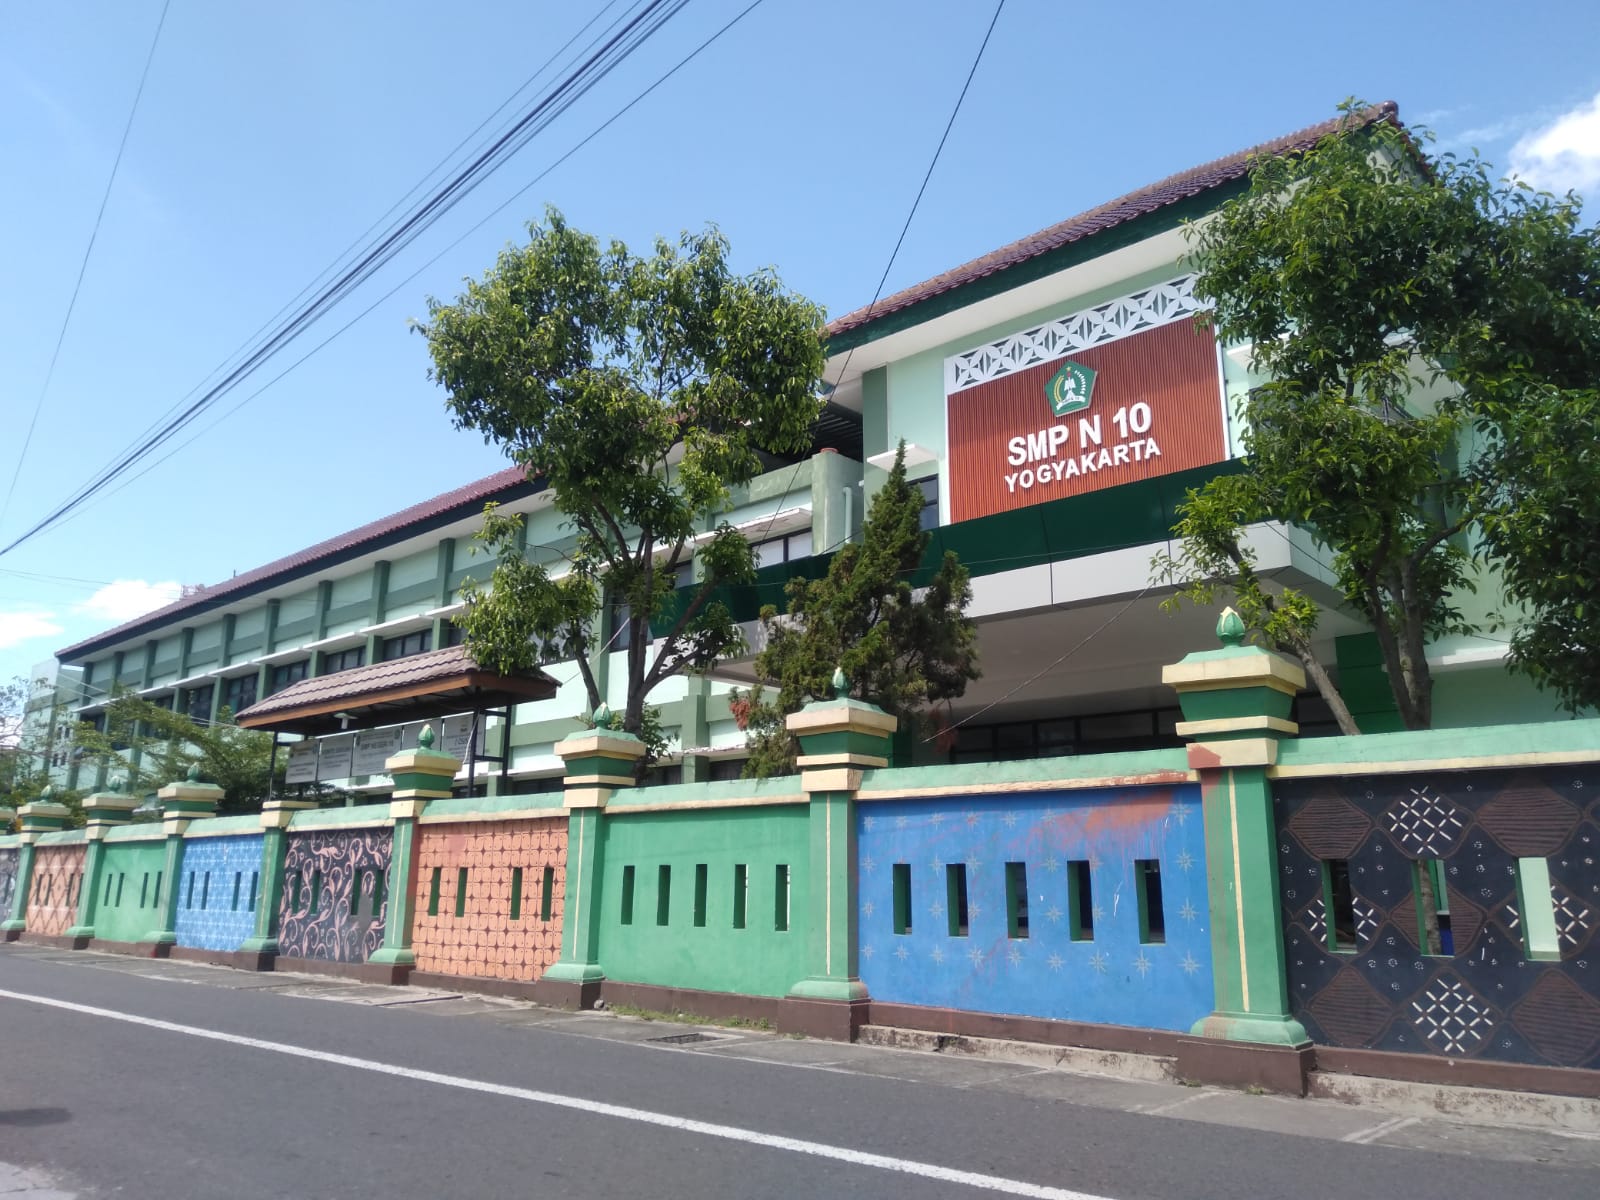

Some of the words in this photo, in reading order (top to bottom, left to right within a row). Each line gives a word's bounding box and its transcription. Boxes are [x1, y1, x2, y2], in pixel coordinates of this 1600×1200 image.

[1007, 424, 1070, 467] SMP
[1079, 414, 1102, 450] N
[1112, 401, 1153, 439] 10
[1003, 437, 1162, 494] YOGYAKARTA
